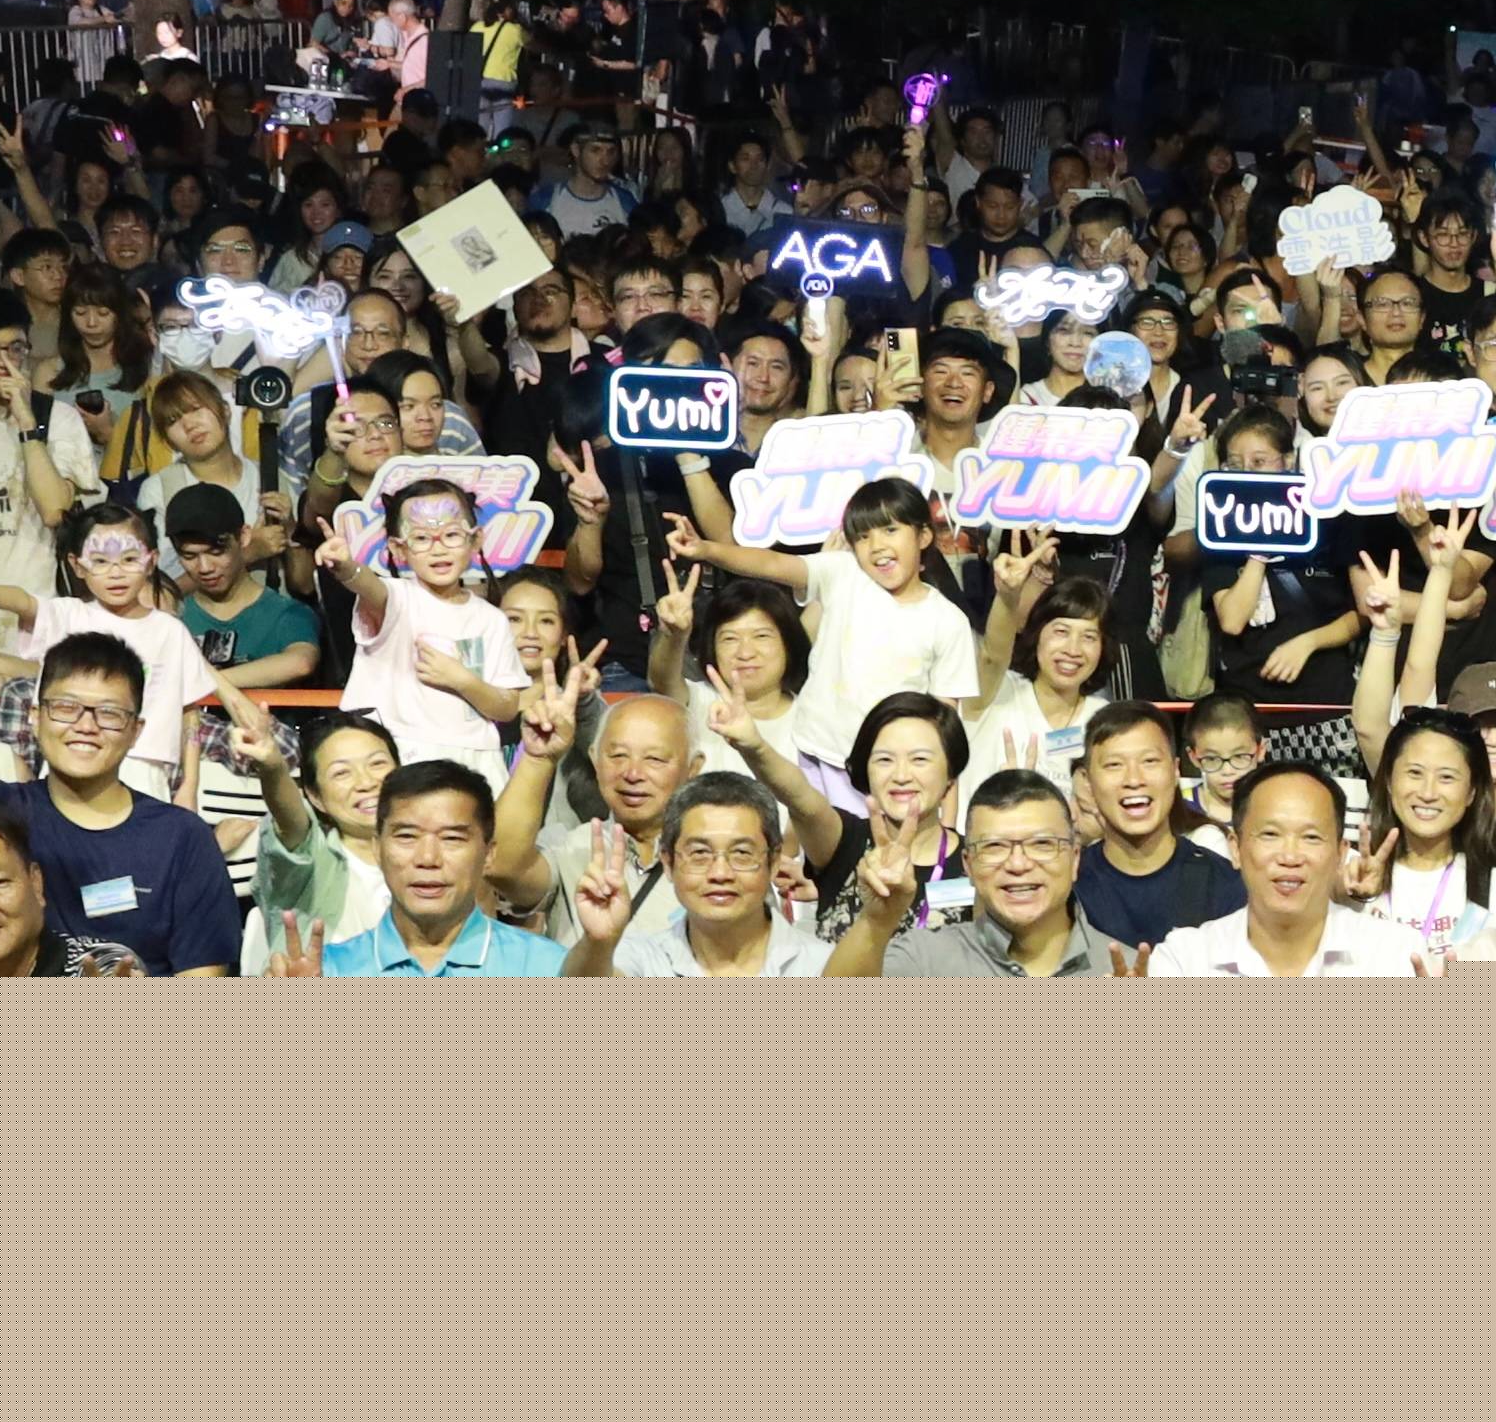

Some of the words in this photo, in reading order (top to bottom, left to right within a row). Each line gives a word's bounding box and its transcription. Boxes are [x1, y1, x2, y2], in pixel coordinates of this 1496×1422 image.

[1282, 199, 1375, 235] Cloud
[771, 231, 892, 282] AGA
[1281, 226, 1393, 273] 雲浩影
[608, 382, 730, 433] Yumi
[986, 413, 1129, 460] 鍾柔美
[957, 457, 1140, 524] YUMI
[1205, 488, 1305, 538] Yumi
